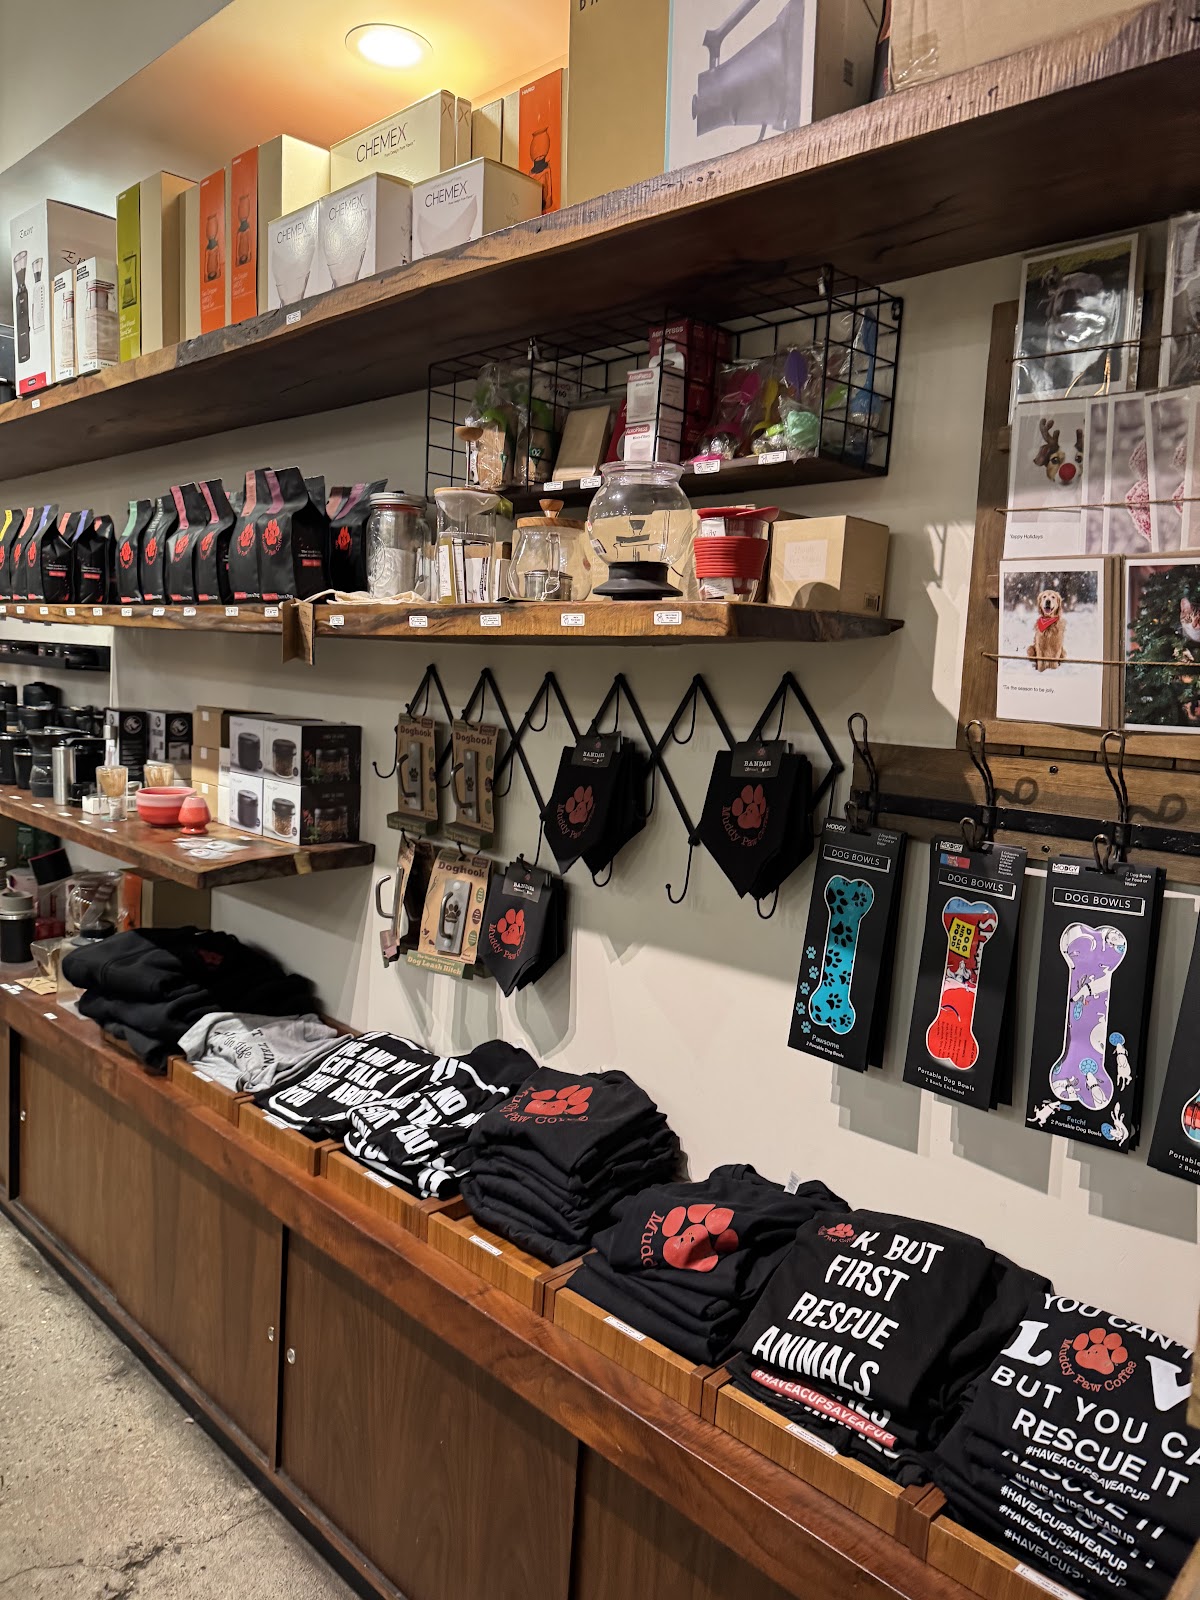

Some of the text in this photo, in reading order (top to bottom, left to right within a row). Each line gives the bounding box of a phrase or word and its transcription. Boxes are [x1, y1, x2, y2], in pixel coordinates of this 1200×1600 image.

[356, 122, 408, 163] CHEMEX
[425, 180, 468, 208] CHEMEX
[400, 725, 432, 738] Doghook
[455, 731, 493, 746] Doghook
[721, 805, 741, 842] Muddy
[437, 861, 485, 879] Doghook
[831, 849, 880, 867] DOG BOWLS
[947, 873, 1004, 893] DOG BOWLS
[1064, 892, 1131, 909] DOG BOWLS
[488, 923, 504, 954] Muddy
[961, 927, 972, 952] DOG
[407, 956, 421, 967] Dog
[420, 959, 443, 971] Leash
[811, 1034, 840, 1050] Pawsome
[338, 1041, 422, 1075] ME AND MY
[321, 1056, 390, 1090] CAT TALK
[917, 1066, 975, 1092] Portable Dog Bowls
[278, 1085, 318, 1108] YOU
[326, 1081, 384, 1107] ABOUT
[1054, 1120, 1076, 1131] Portable
[1075, 1125, 1087, 1134] Dog
[1087, 1128, 1102, 1138] Bowls
[1168, 1149, 1200, 1167] Portable
[883, 1233, 945, 1274] BUT
[824, 1254, 910, 1302] FIRST
[1043, 1292, 1103, 1318] YOU
[787, 1291, 900, 1350] RESCUE
[751, 1324, 881, 1399] ANIMALS
[1058, 1338, 1138, 1393] Muddy Paw Coffee
[754, 1370, 896, 1442] #HAVEACUPSAVEAPUP
[990, 1365, 1062, 1410] BUT
[1075, 1395, 1149, 1445] YOU
[1011, 1407, 1190, 1498] RESCUE IT
[1025, 1445, 1151, 1503] #HAVEACUPSAVEAPUP
[1000, 1484, 1129, 1572] #HAVEACUPSAVEAPUP
[998, 1504, 1128, 1588] #HAVEACUPSAVEAPUP
